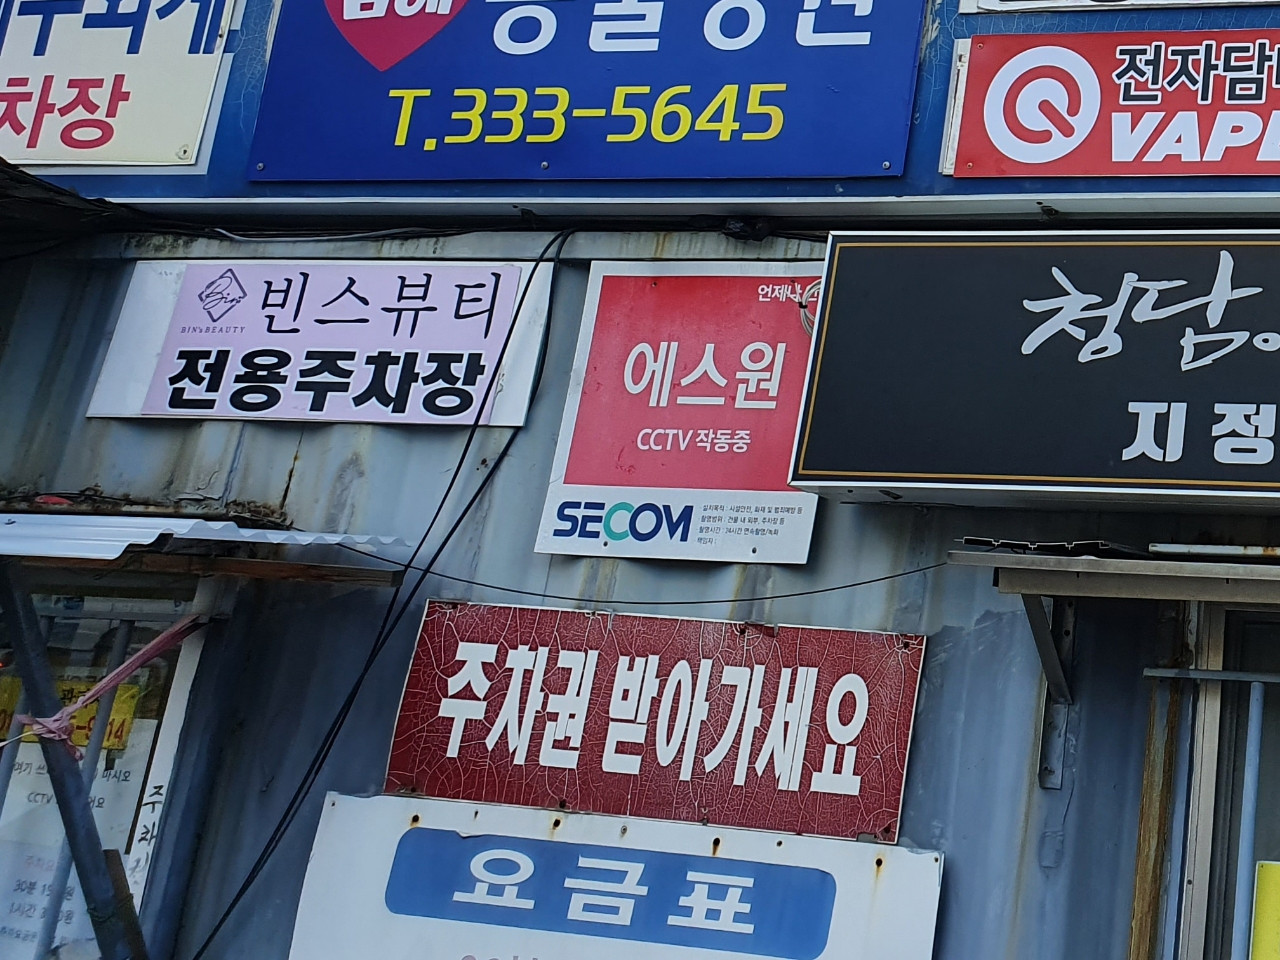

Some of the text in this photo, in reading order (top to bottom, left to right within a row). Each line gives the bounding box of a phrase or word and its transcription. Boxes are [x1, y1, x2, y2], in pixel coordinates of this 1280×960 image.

[261, 271, 502, 340] 빈스뷰티
[168, 349, 487, 416] 전용주차장
[623, 341, 787, 410] 에스원
[636, 428, 751, 453] CCTV 작동중
[552, 501, 694, 542] SECOM
[438, 641, 869, 796] 주차권 받아가세요
[452, 848, 756, 935] 요금표
